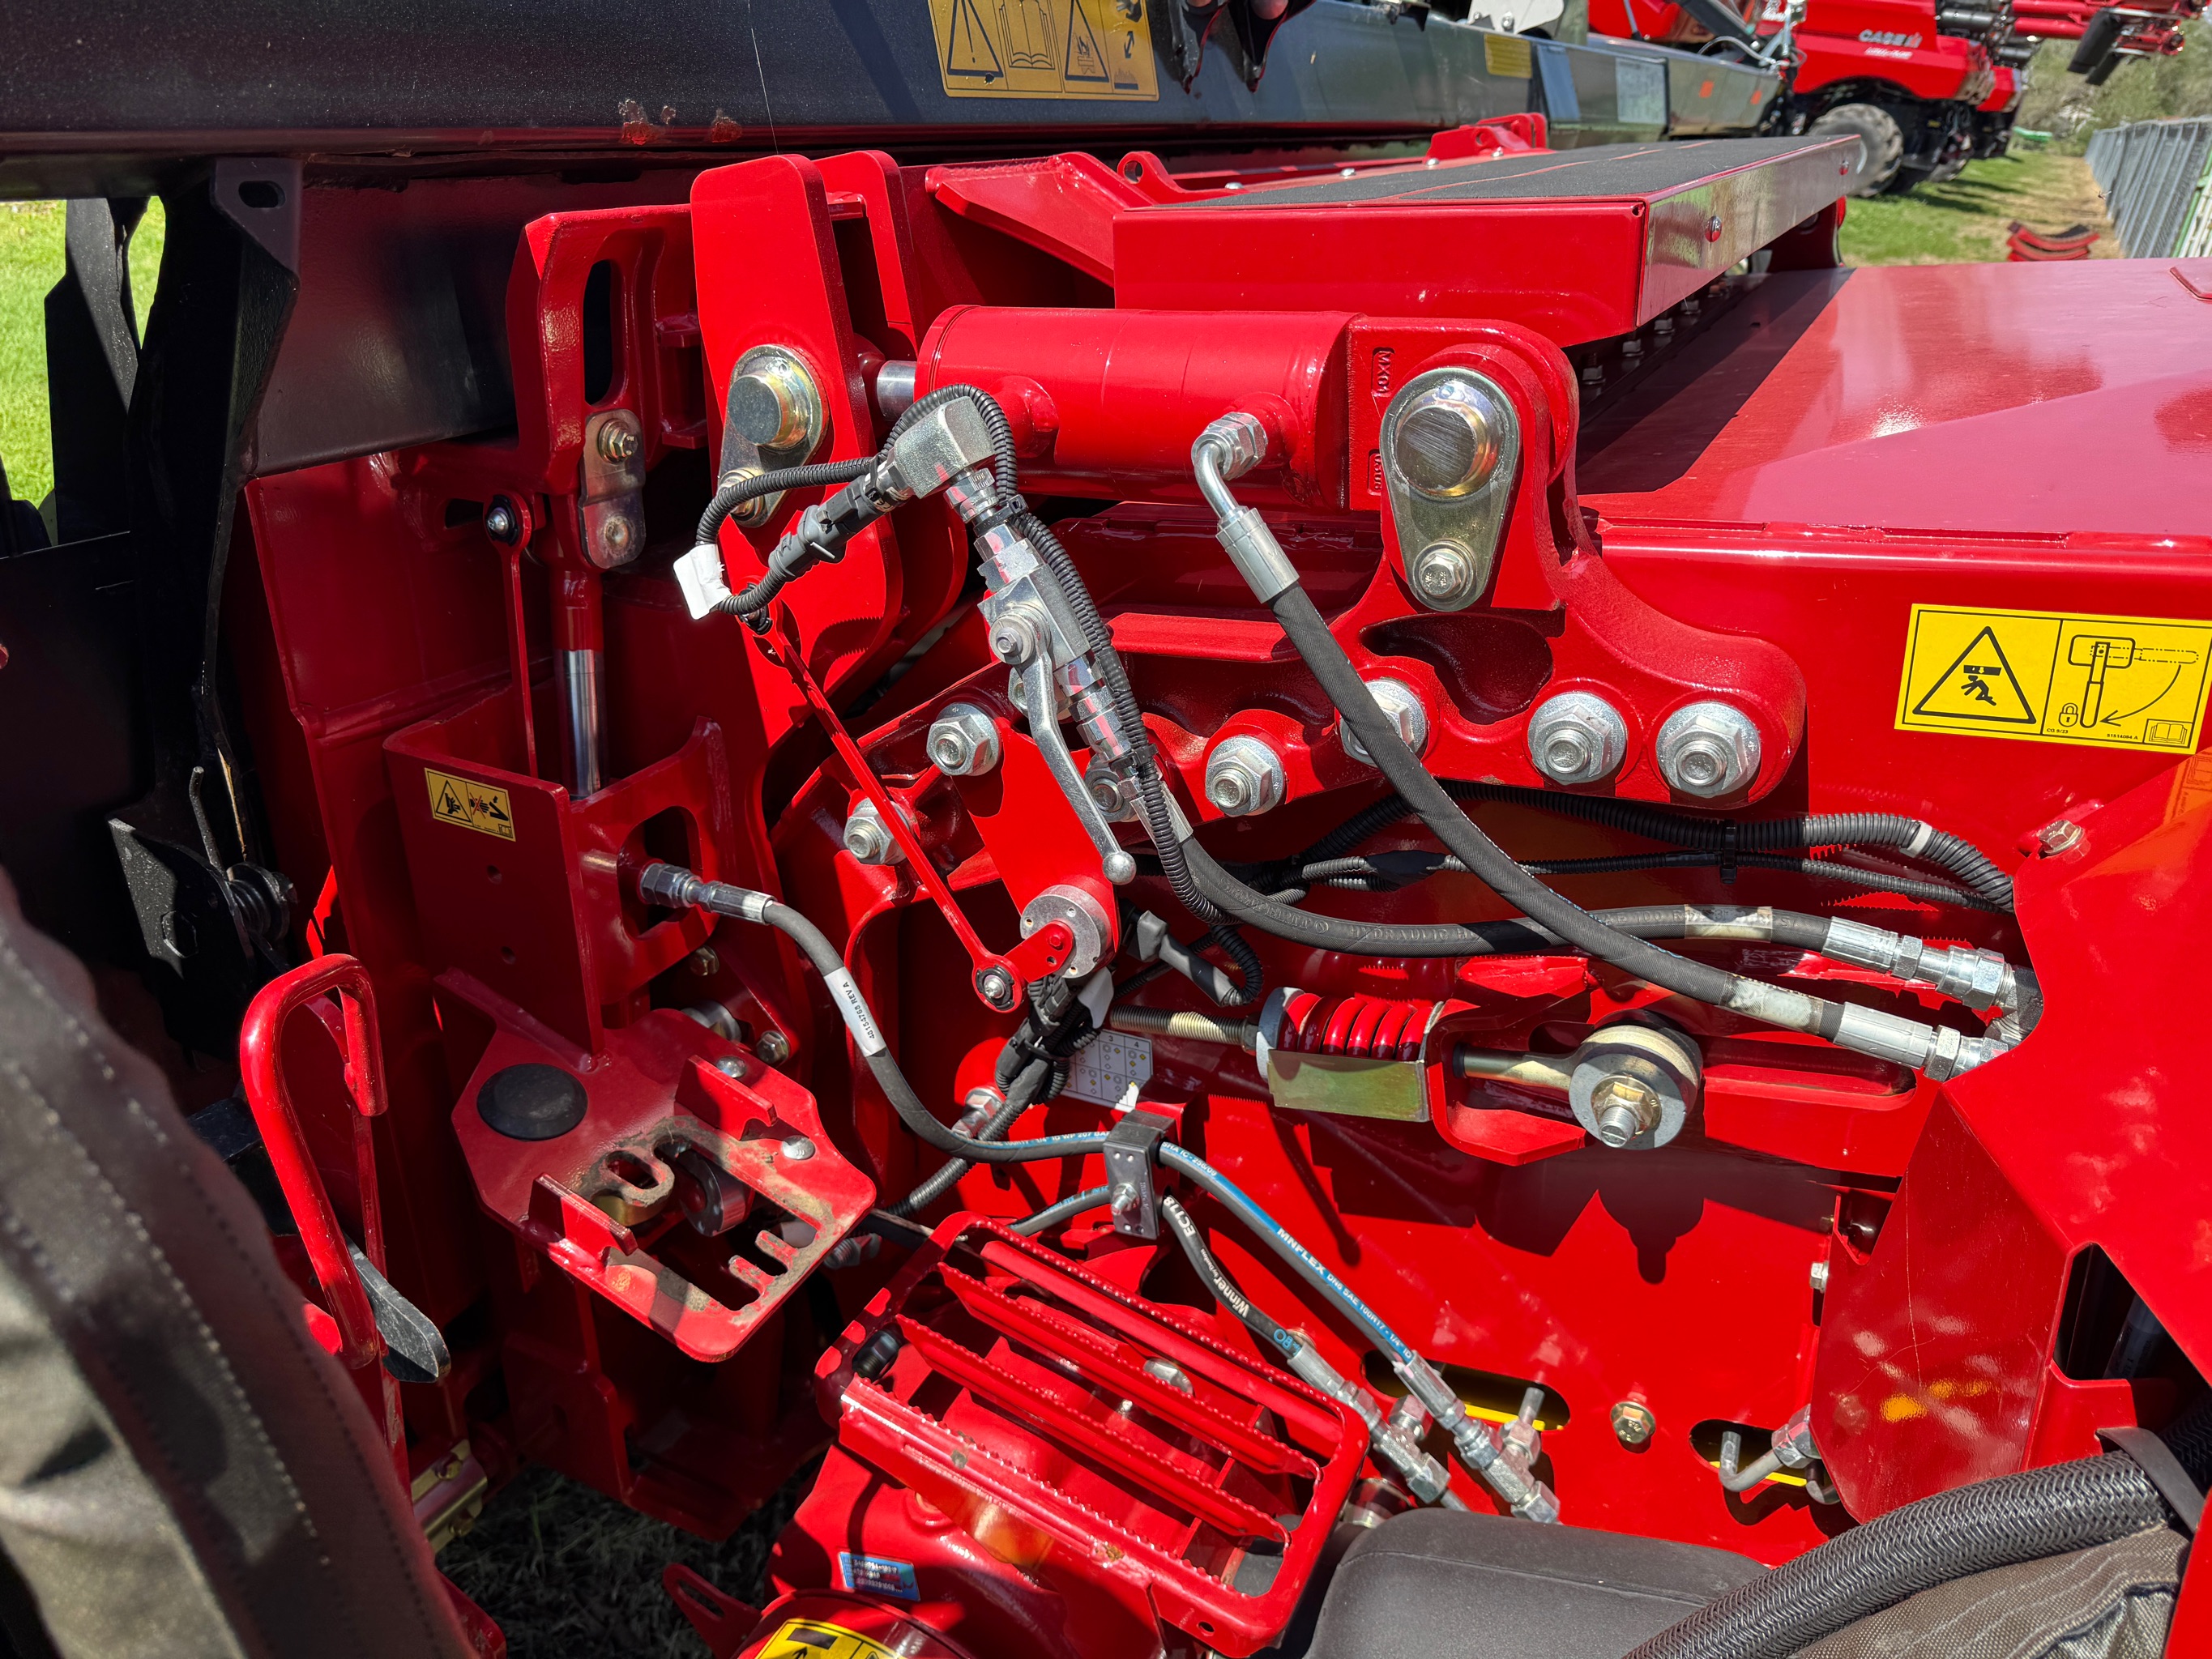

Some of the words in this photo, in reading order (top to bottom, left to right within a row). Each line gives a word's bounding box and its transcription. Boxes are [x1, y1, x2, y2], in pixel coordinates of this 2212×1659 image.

[1348, 927, 1449, 941] HYDRAULIC
[845, 989, 858, 1004] REV
[1162, 1141, 1179, 1153] SHA
[1163, 1196, 1196, 1238] EC118
[1277, 1227, 1326, 1275] MNFLEX
[1343, 1288, 1360, 1305] SAE
[1360, 1303, 1386, 1331] 100R17
[1213, 1276, 1250, 1319] Winner
